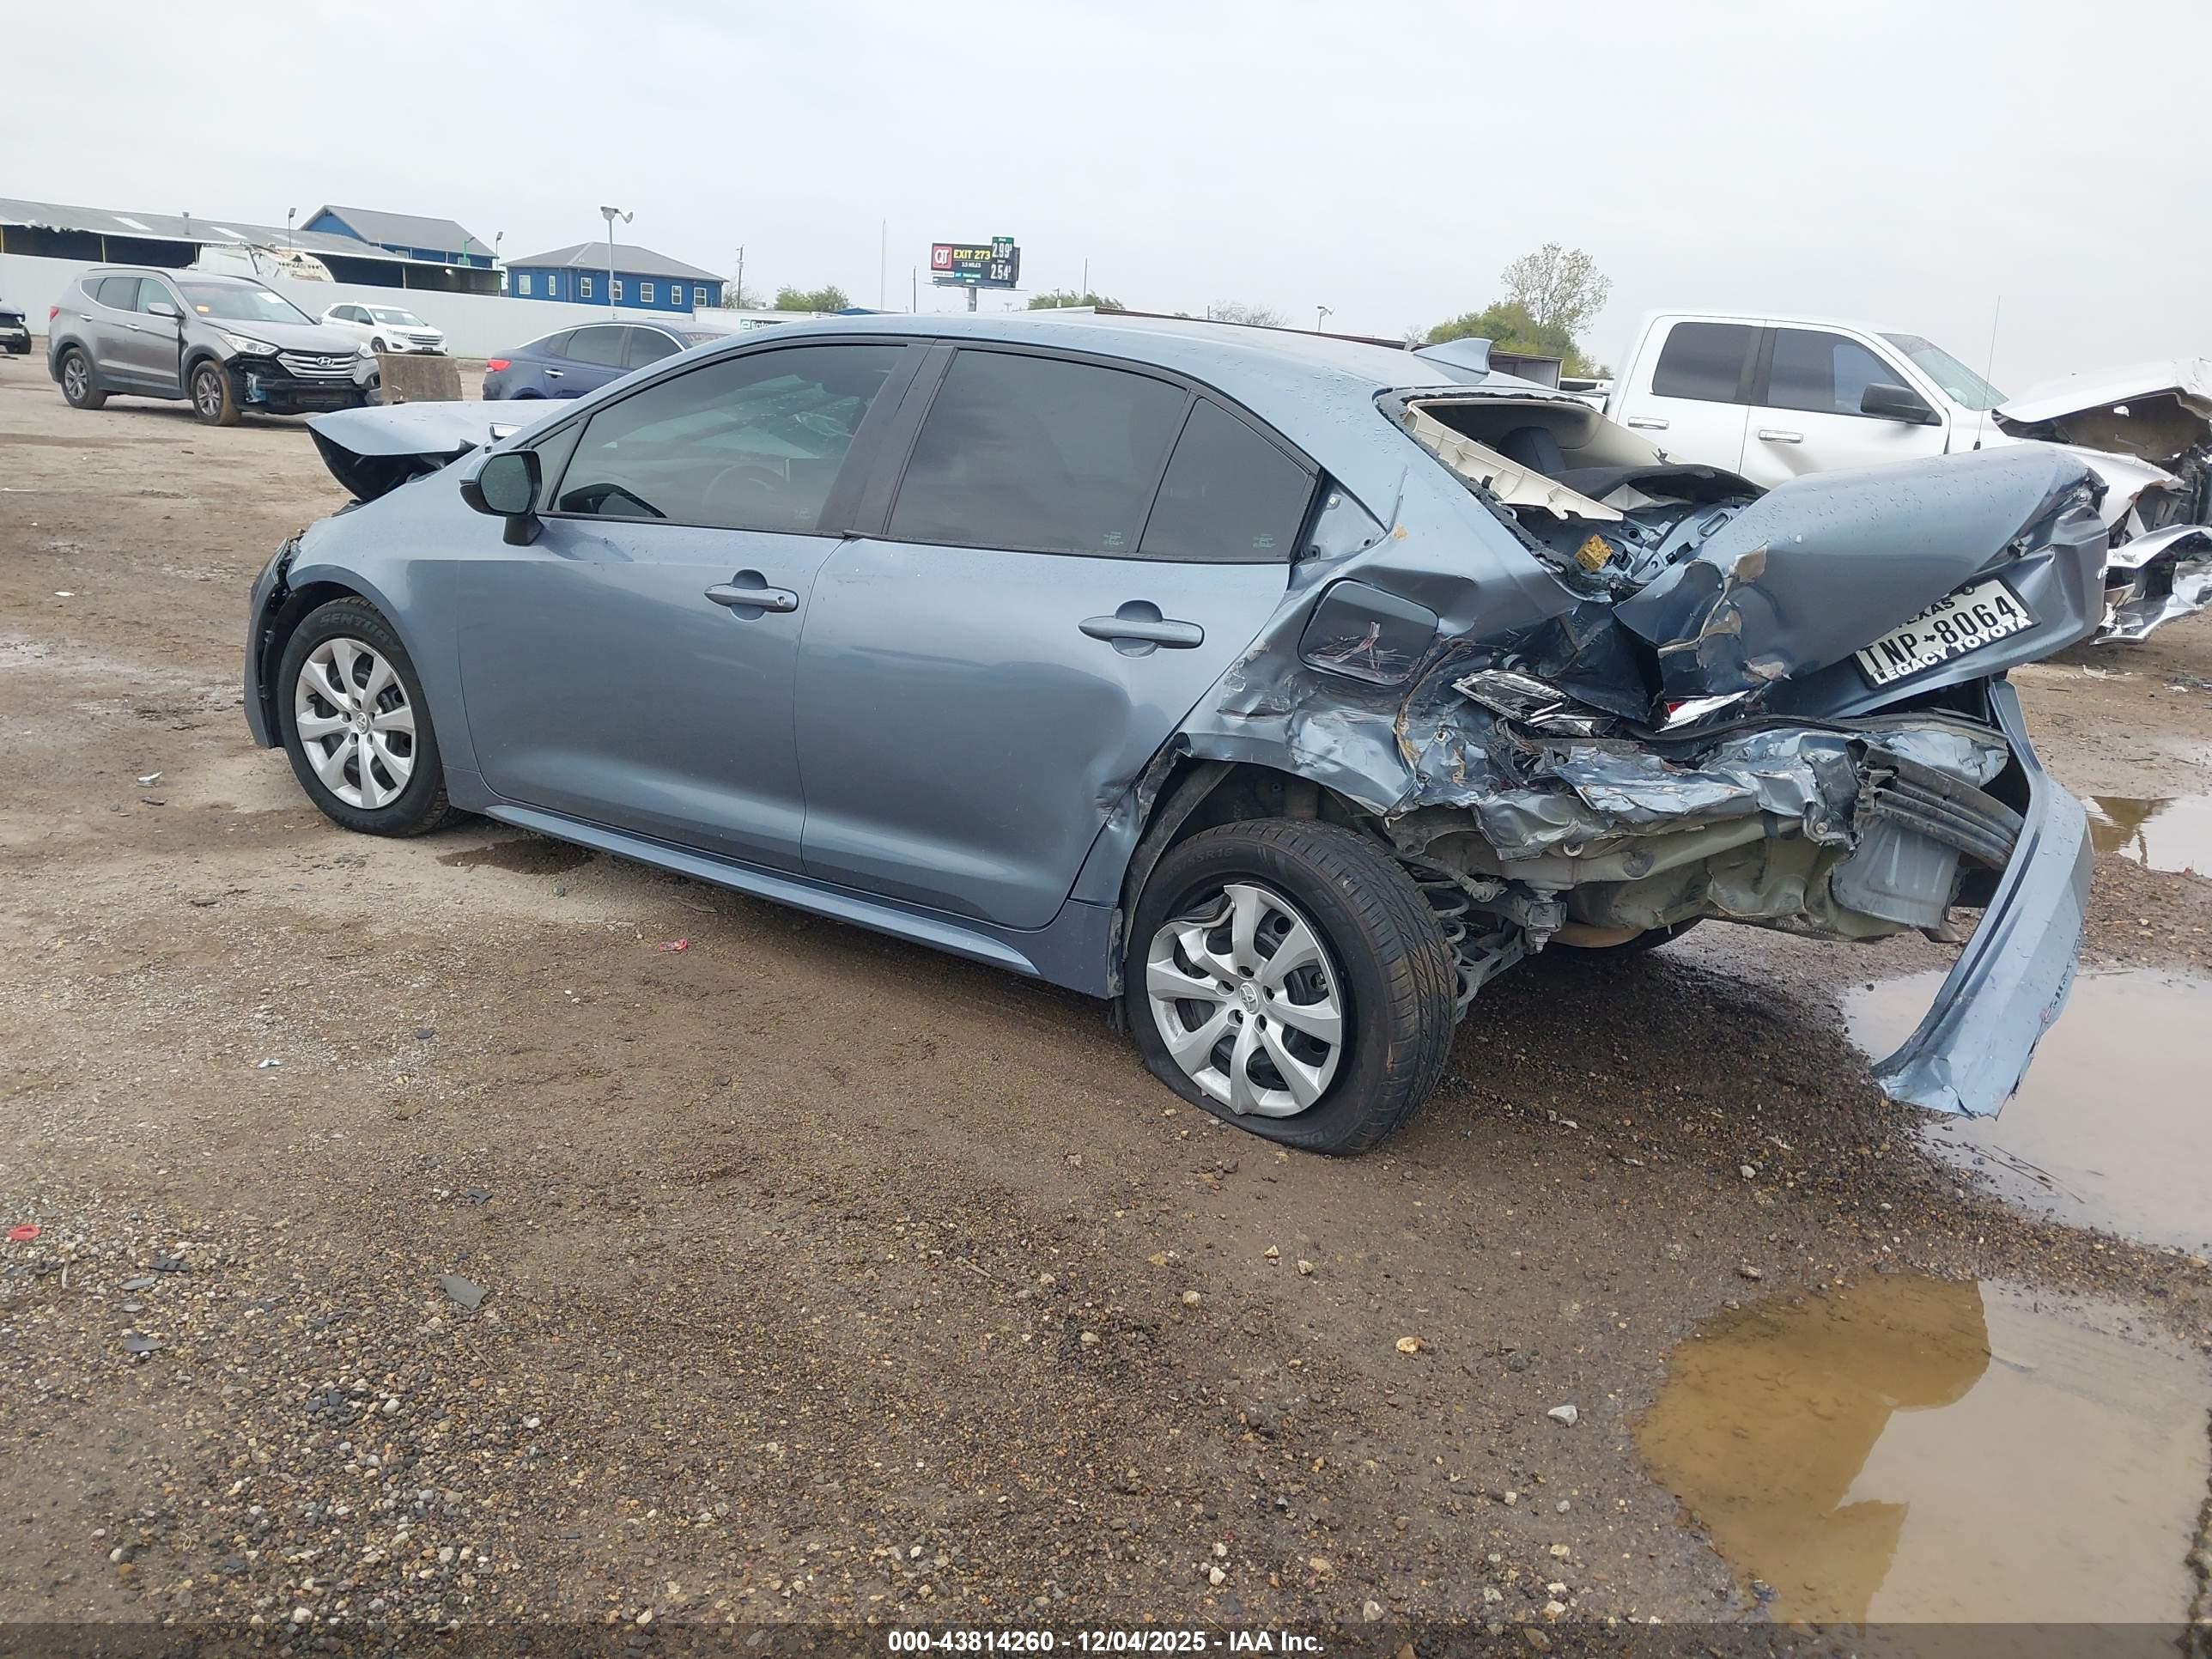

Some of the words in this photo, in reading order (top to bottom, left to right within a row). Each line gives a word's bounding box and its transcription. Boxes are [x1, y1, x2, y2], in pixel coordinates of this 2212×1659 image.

[934, 249, 949, 264] QT
[953, 249, 973, 258] EXIT
[974, 250, 991, 260] 273
[1861, 634, 1917, 670] TNP
[1933, 596, 2016, 644] 8064
[1873, 646, 1948, 684] LEGACY
[1951, 617, 2033, 653] TOYOTA
